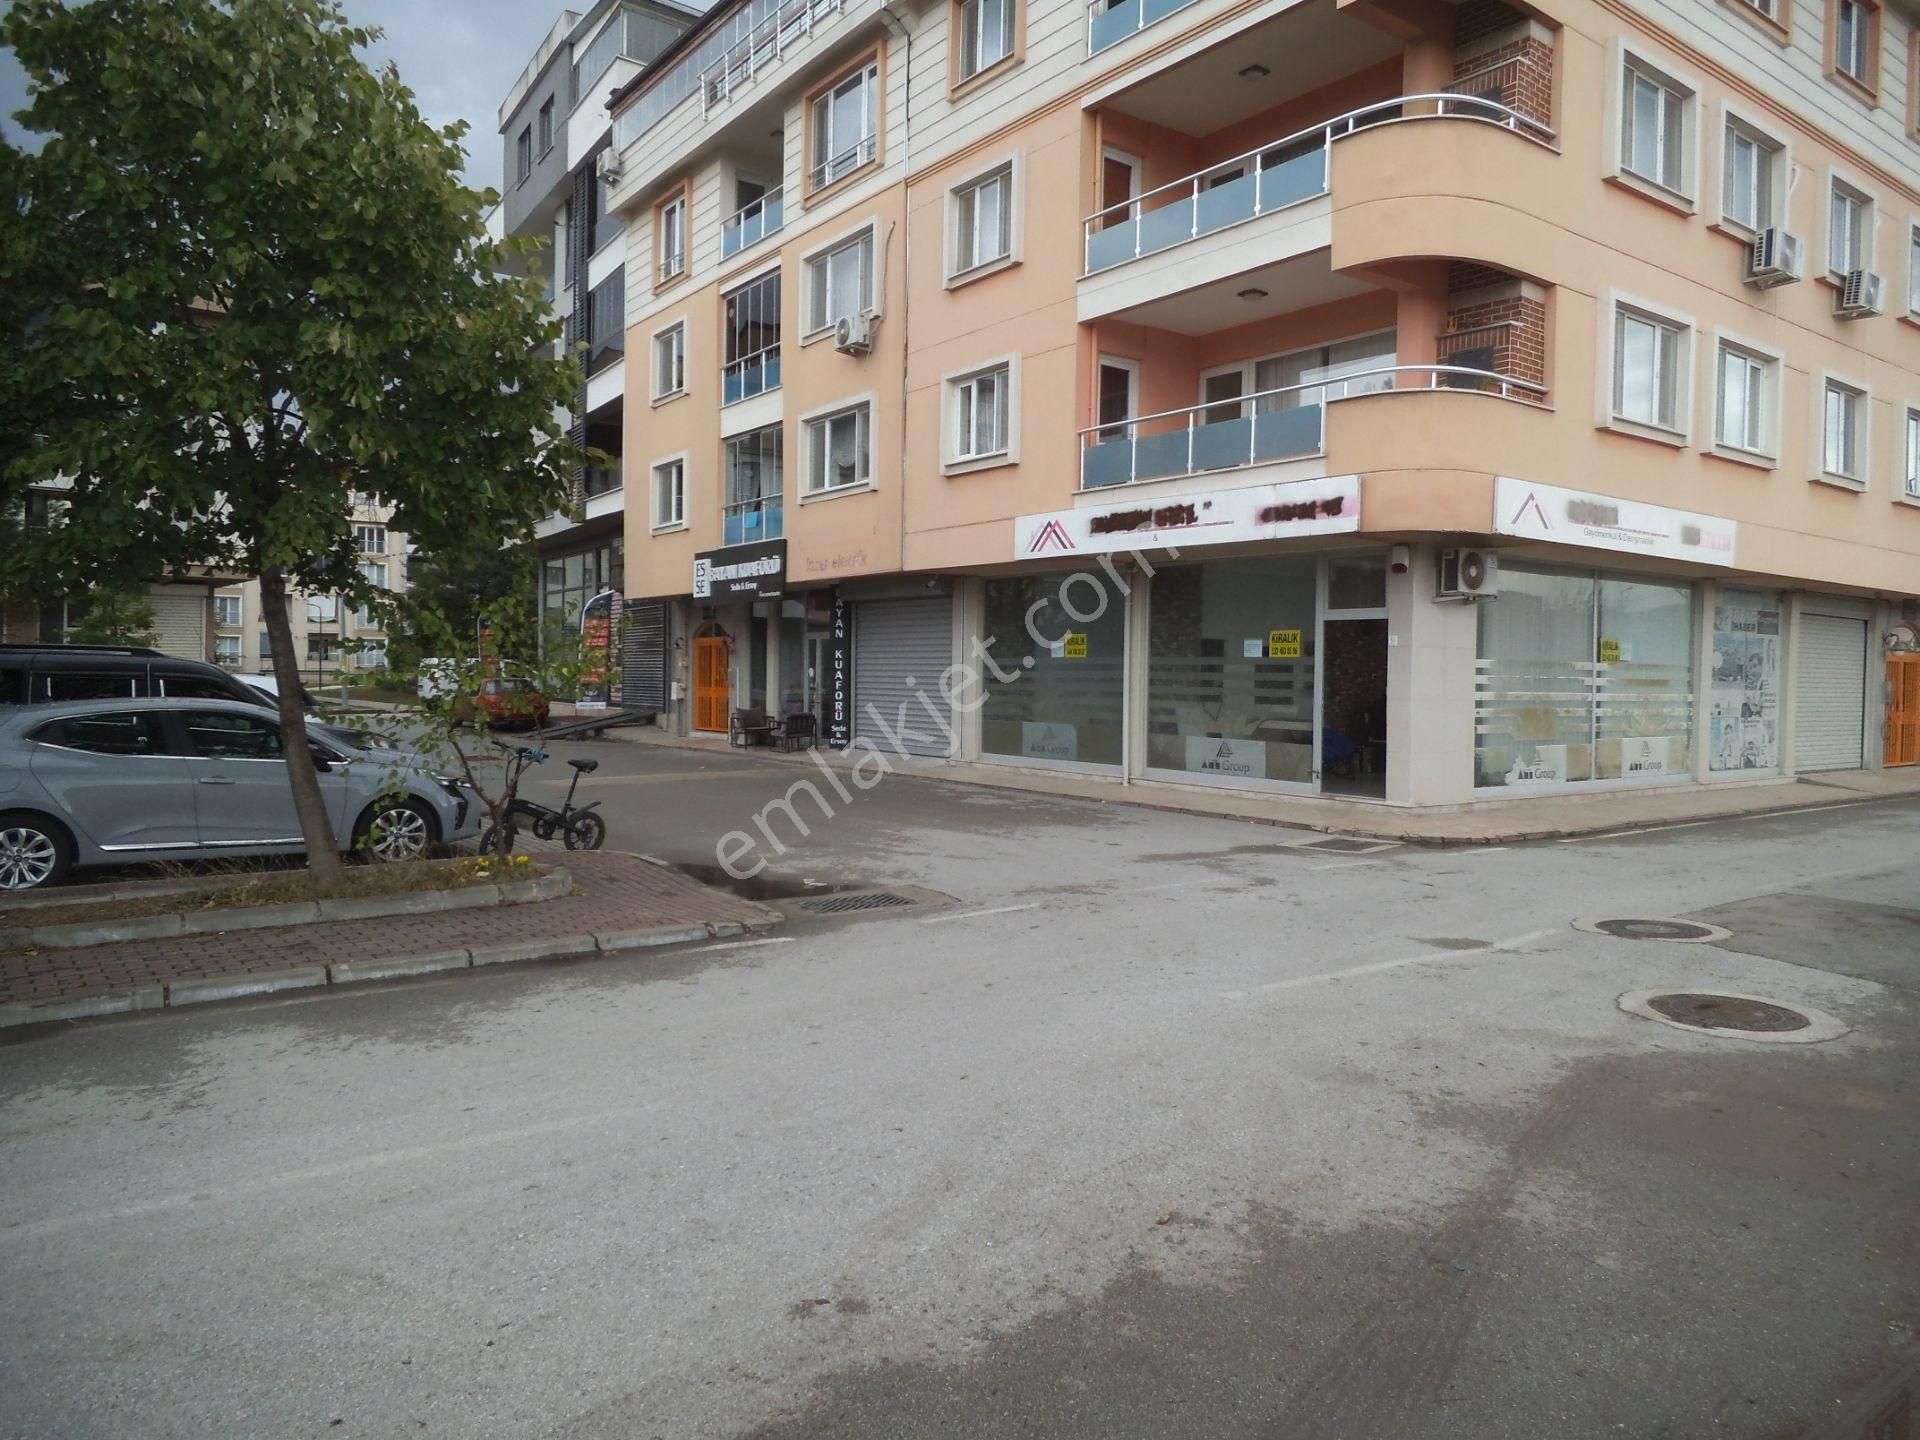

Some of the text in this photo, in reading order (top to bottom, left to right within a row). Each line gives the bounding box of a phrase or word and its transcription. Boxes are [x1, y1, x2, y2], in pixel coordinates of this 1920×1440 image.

[696, 562, 706, 577] ES
[695, 580, 705, 594] SE
[835, 586, 844, 638] AYAN
[1222, 760, 1250, 774] Group
[1535, 768, 1556, 781] Group
